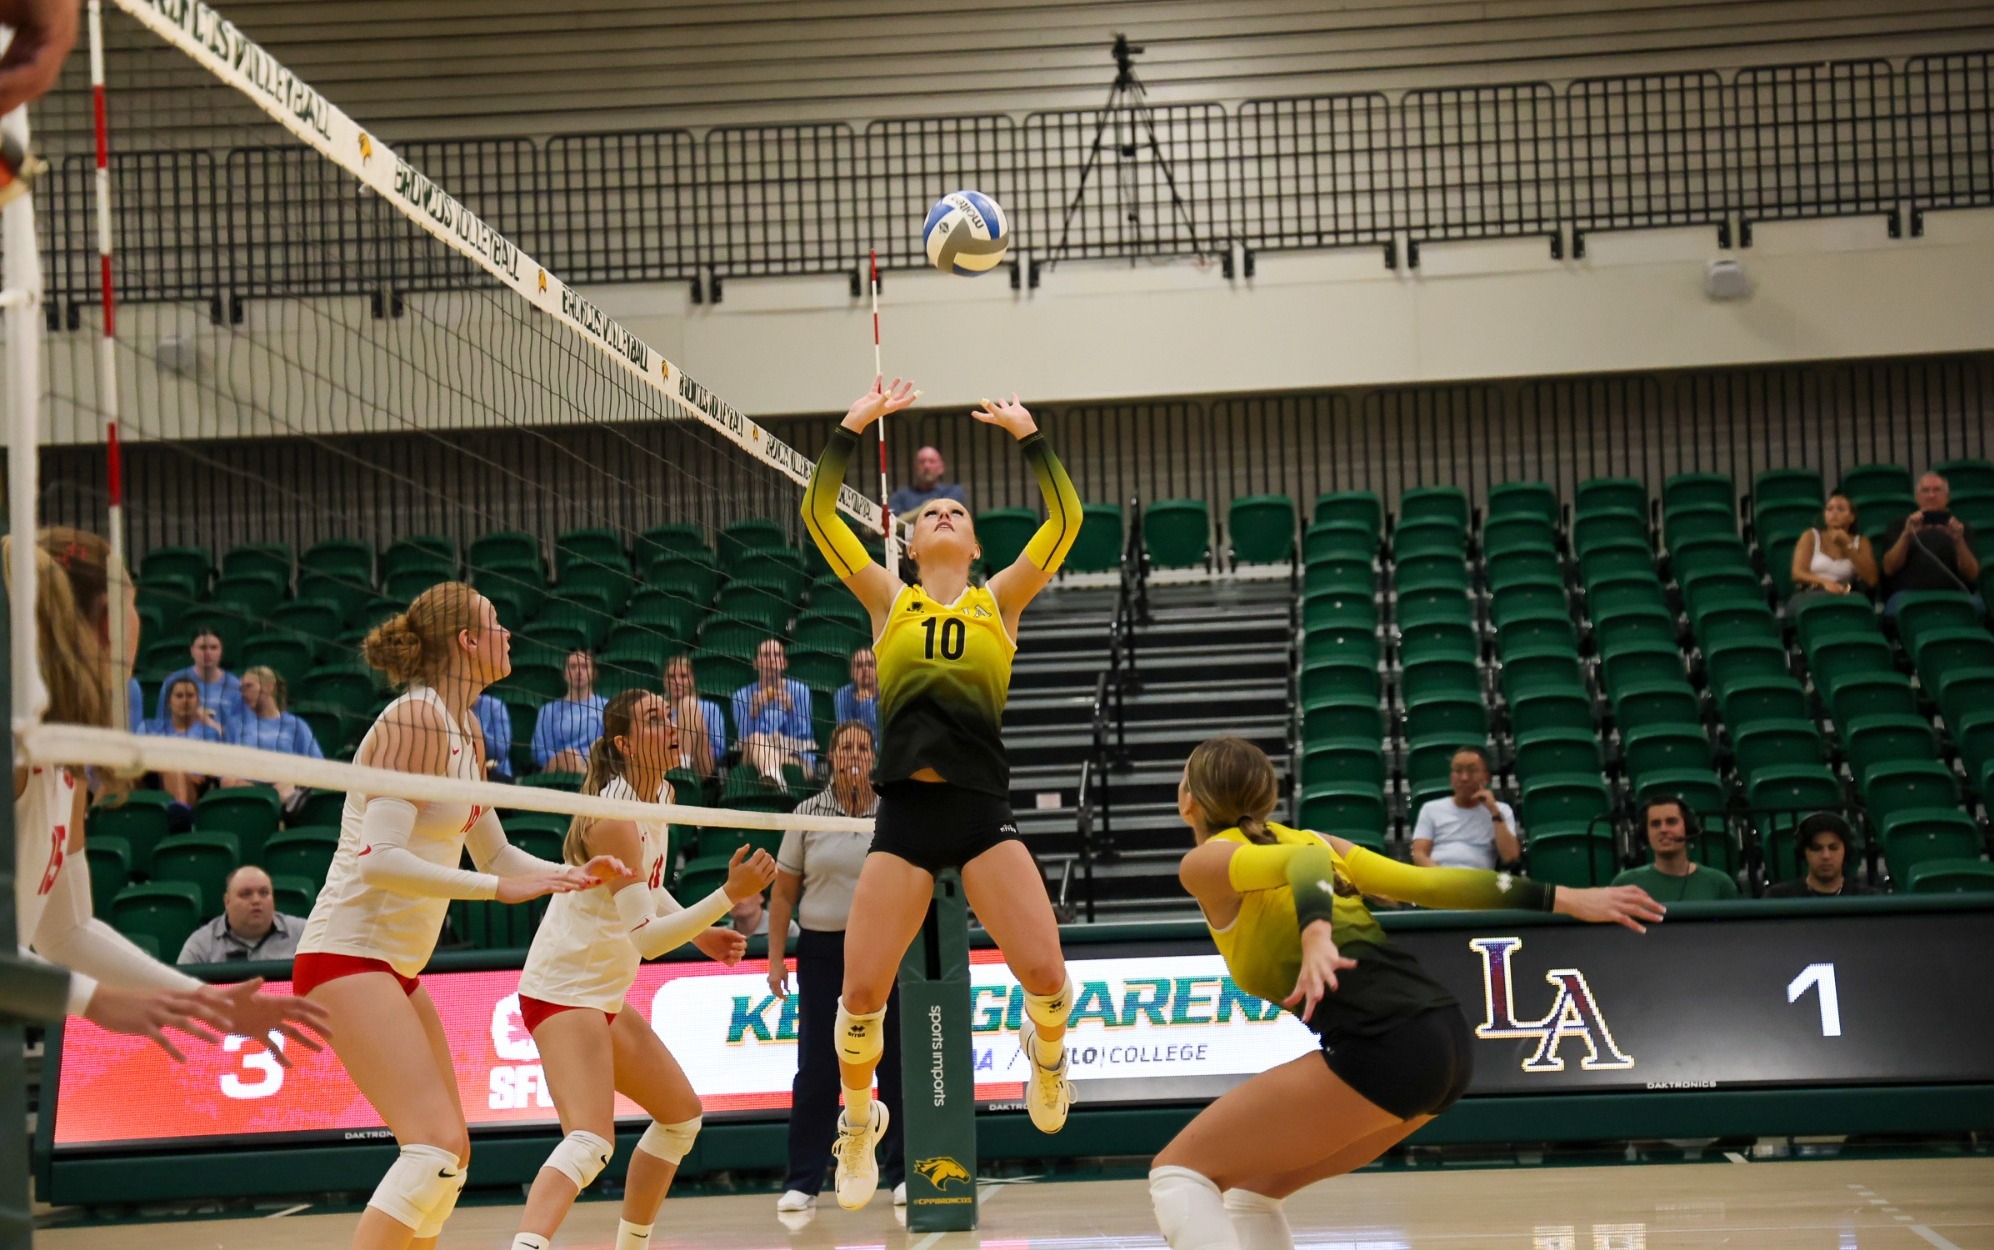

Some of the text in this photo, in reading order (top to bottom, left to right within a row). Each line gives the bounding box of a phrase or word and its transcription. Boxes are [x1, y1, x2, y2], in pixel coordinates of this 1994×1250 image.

[921, 616, 966, 661] 10
[1469, 937, 1635, 1072] LA
[1787, 962, 1841, 1037] 1
[221, 1028, 286, 1099] 3
[928, 1005, 946, 1107] sports imports
[1110, 1044, 1208, 1063] COLLEGE
[1647, 1080, 1717, 1089] DAKTRONICS
[344, 1130, 394, 1140] DAKTRON
